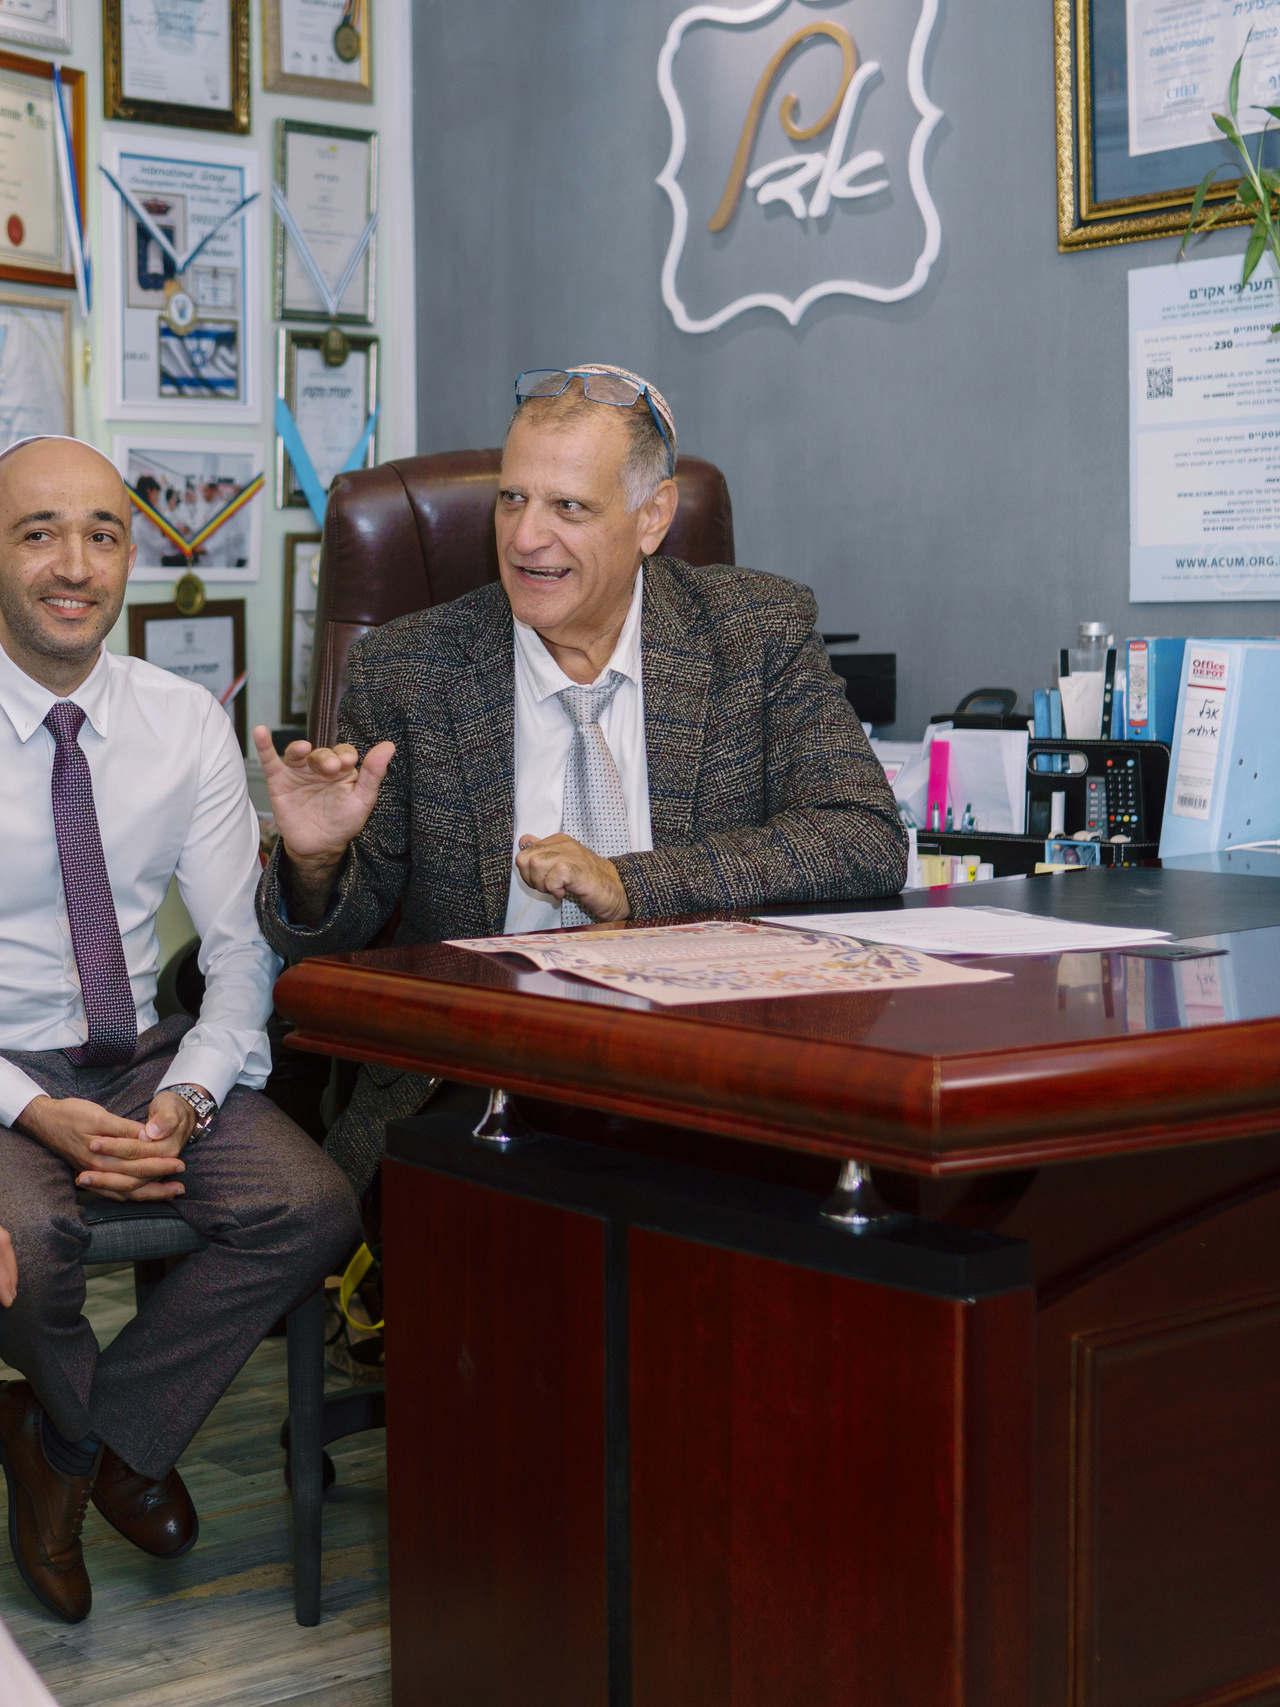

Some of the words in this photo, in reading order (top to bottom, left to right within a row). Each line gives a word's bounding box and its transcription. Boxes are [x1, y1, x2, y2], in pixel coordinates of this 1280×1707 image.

[1188, 285, 1225, 300] אקו"ם
[1229, 279, 1273, 295] תערפי
[1214, 340, 1233, 351] 230
[1175, 554, 1280, 569] WWW.ACUM.ORG.
[1192, 658, 1226, 671] Office
[1192, 668, 1224, 678] DEPOT
